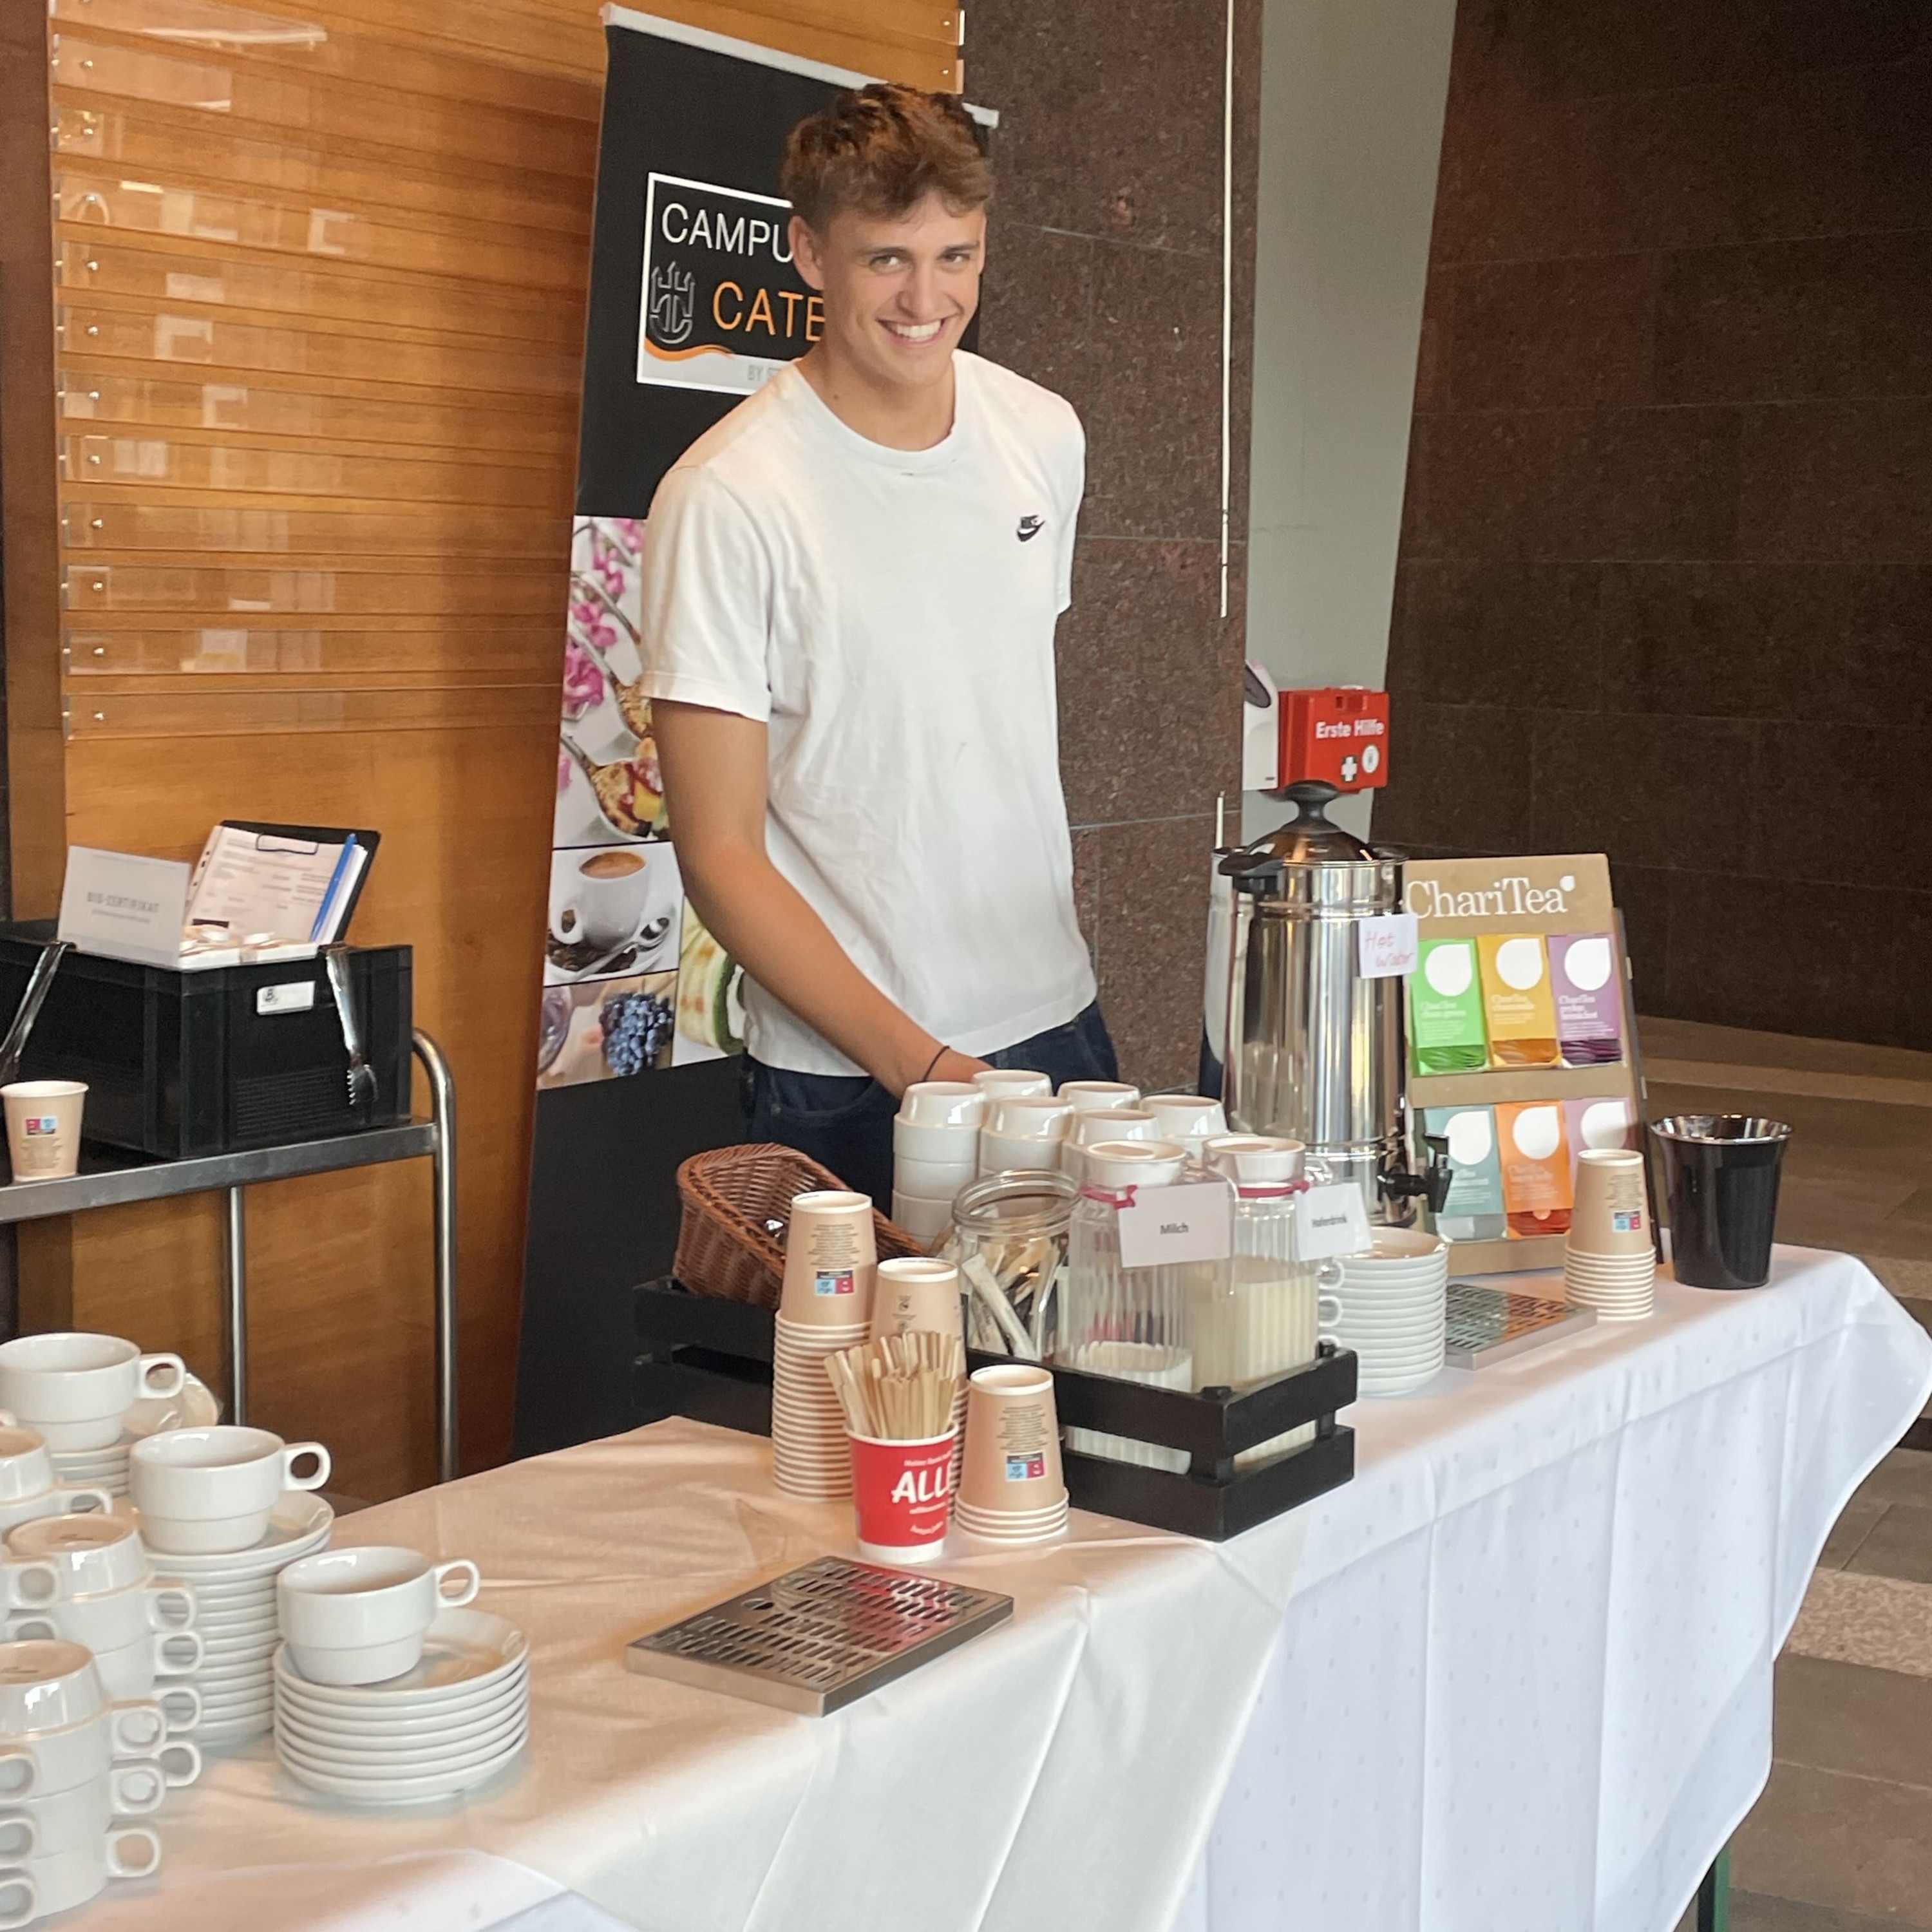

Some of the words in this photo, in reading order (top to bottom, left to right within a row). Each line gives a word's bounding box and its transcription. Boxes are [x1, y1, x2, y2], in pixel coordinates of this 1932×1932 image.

[712, 281, 826, 342] CATE
[748, 364, 764, 382] BY
[1316, 721, 1352, 739] Erste
[1354, 718, 1385, 737] Hilfe
[1405, 876, 1568, 919] ChariTea
[1160, 1222, 1189, 1235] Milch
[891, 1459, 951, 1504] ALL
